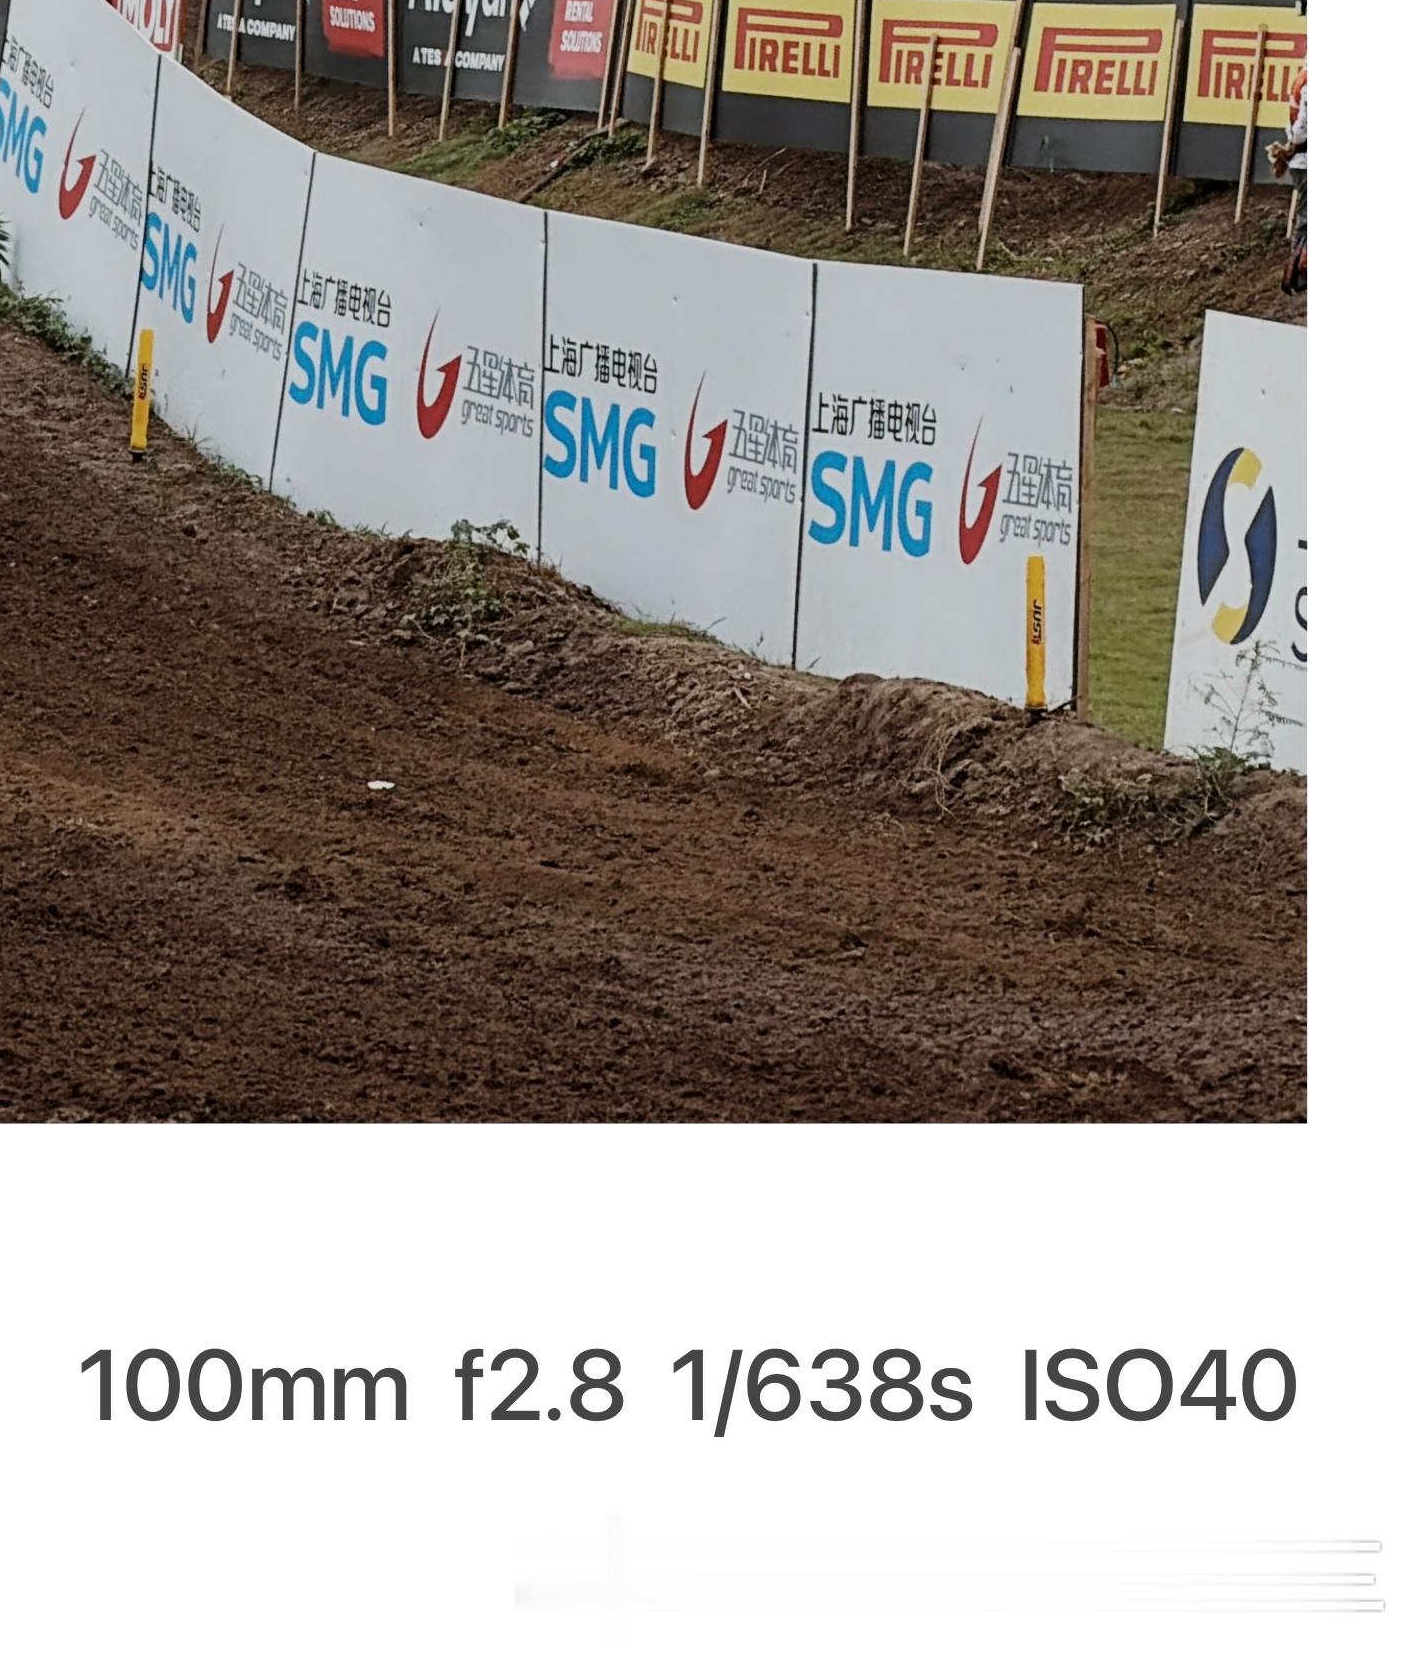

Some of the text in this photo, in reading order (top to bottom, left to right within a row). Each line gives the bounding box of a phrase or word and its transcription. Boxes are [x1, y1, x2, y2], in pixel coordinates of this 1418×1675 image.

[247, 19, 296, 42] COMPANY
[329, 6, 376, 33] SOLUTIONS
[734, 7, 844, 79] PIRELLI
[455, 51, 506, 73] COMPANY
[1033, 27, 1164, 97] PIRELLI
[141, 211, 198, 324] SMG
[298, 268, 392, 329] 上海广播电视台
[289, 320, 388, 426] SMG
[544, 333, 658, 394] 上海广播电视台
[461, 399, 534, 438] great sports
[544, 389, 656, 499] SMG
[812, 392, 937, 447] 上海广播电视台
[727, 466, 797, 503] great sports
[808, 450, 934, 557] SMG
[999, 512, 1072, 548] great sports
